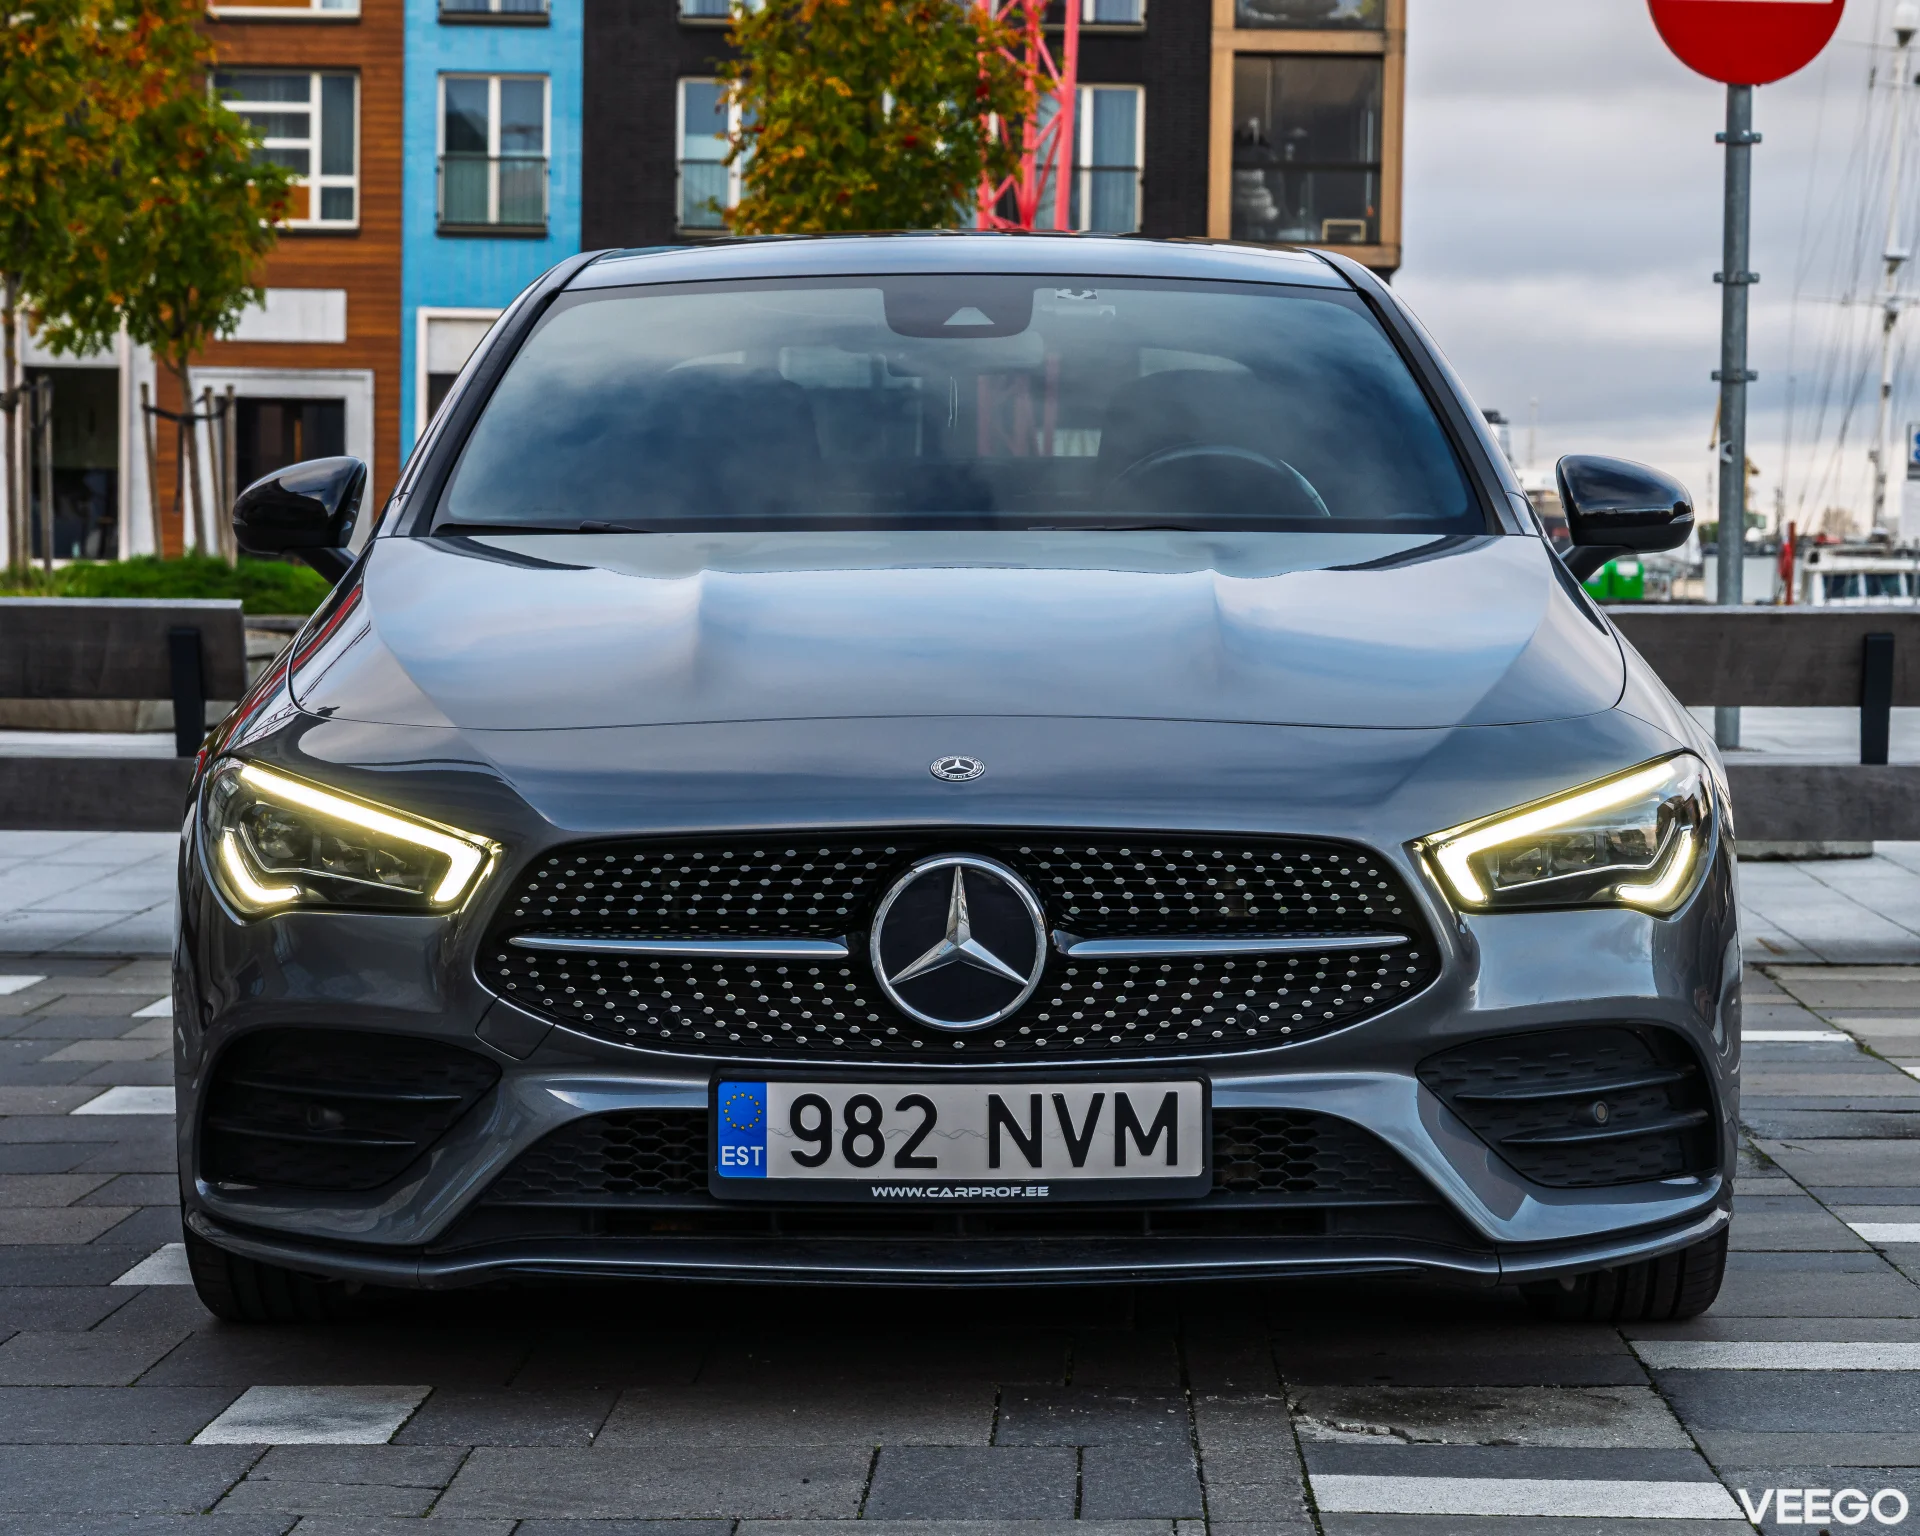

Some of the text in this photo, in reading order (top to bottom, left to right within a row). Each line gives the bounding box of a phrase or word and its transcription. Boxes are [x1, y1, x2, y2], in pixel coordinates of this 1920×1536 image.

[789, 1091, 1179, 1169] 982 NVM
[721, 1145, 764, 1166] EST
[871, 1186, 1050, 1198] WWW.CARPROF.EE
